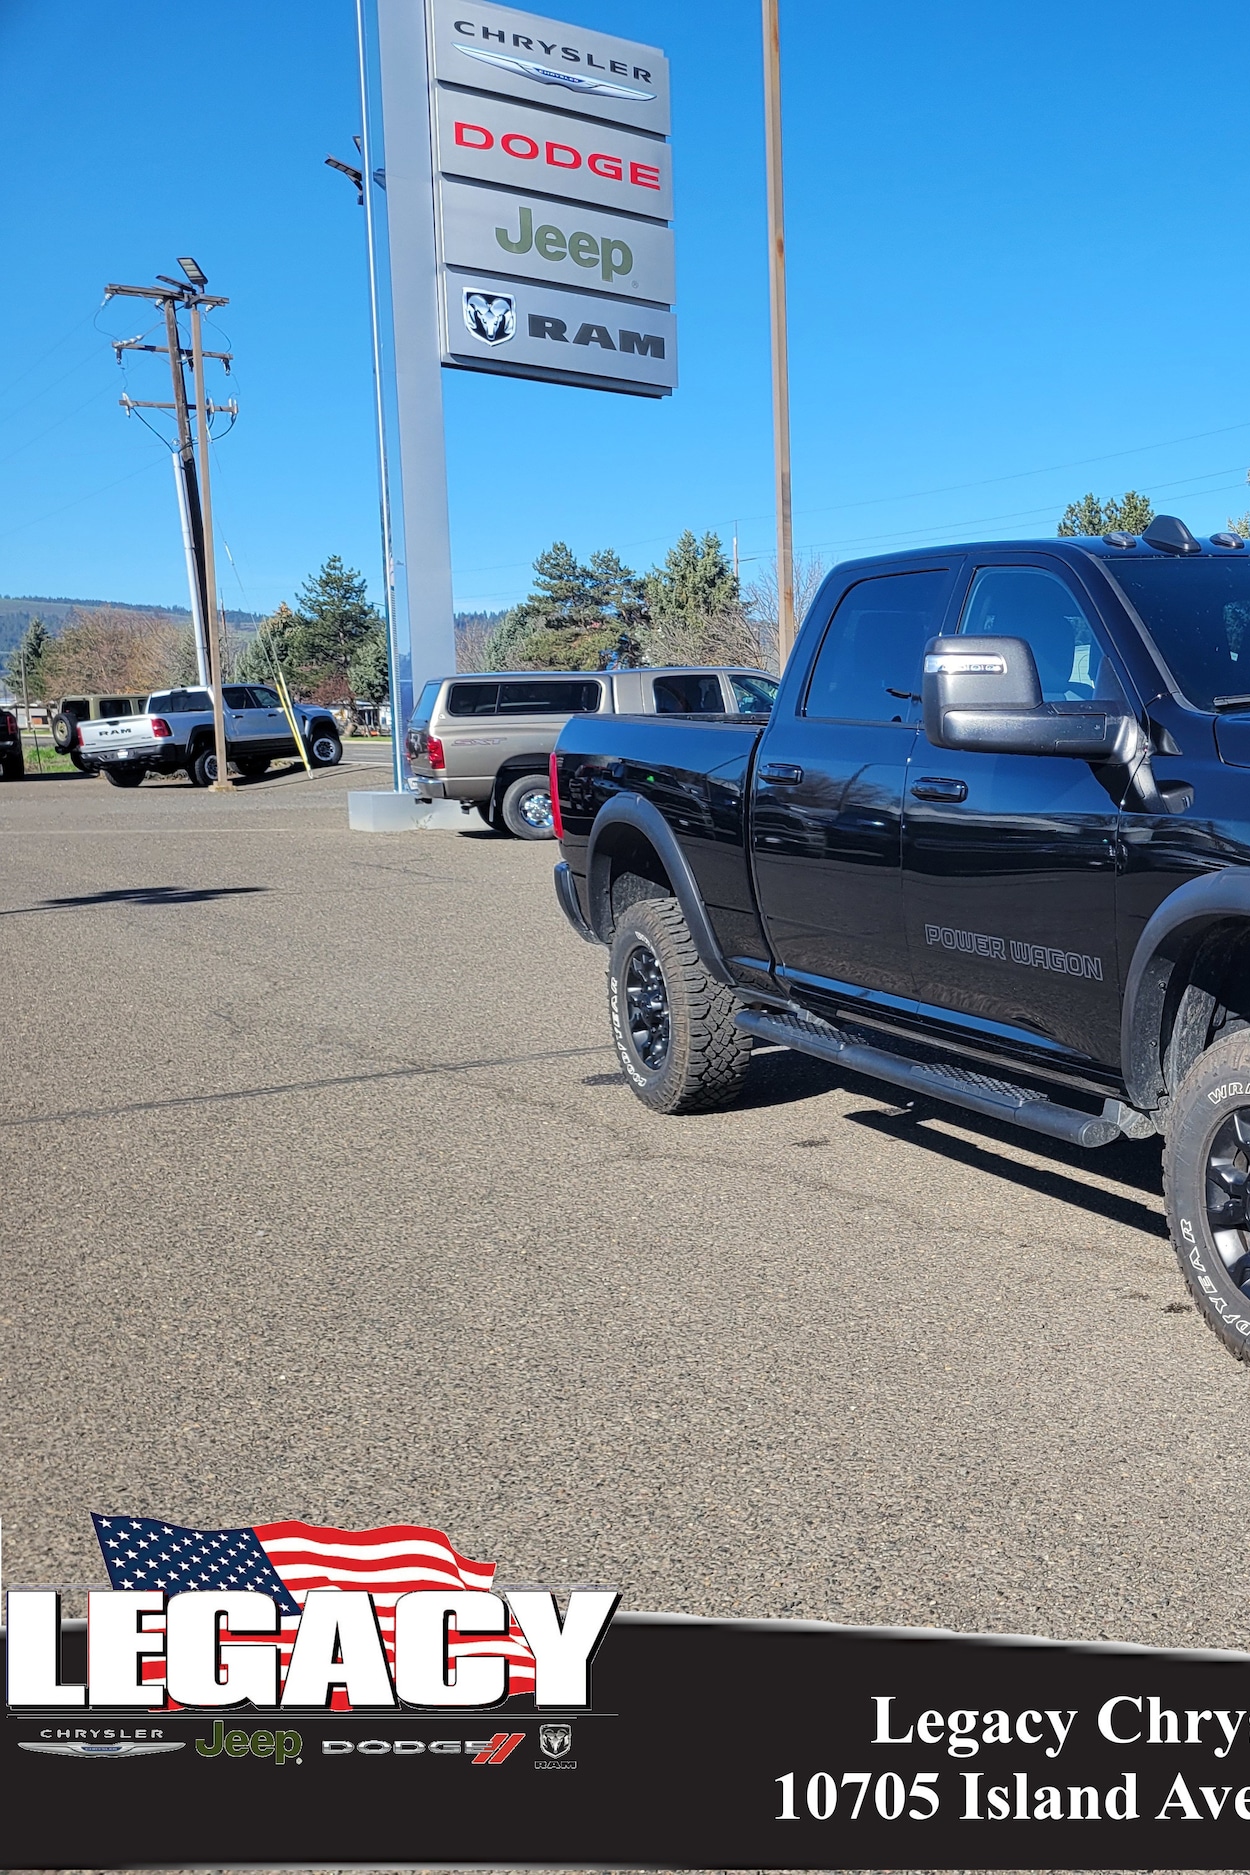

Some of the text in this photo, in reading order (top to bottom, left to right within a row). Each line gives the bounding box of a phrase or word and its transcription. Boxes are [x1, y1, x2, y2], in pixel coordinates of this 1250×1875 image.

[453, 20, 652, 84] CHRYSLER
[454, 121, 661, 191] DODGE
[495, 206, 633, 283] Jeep
[528, 313, 665, 360] RAM
[99, 728, 132, 737] RAM
[451, 737, 507, 747] SXT
[925, 923, 1103, 981] POWER WAGON
[611, 976, 647, 1087] GOODYEAR
